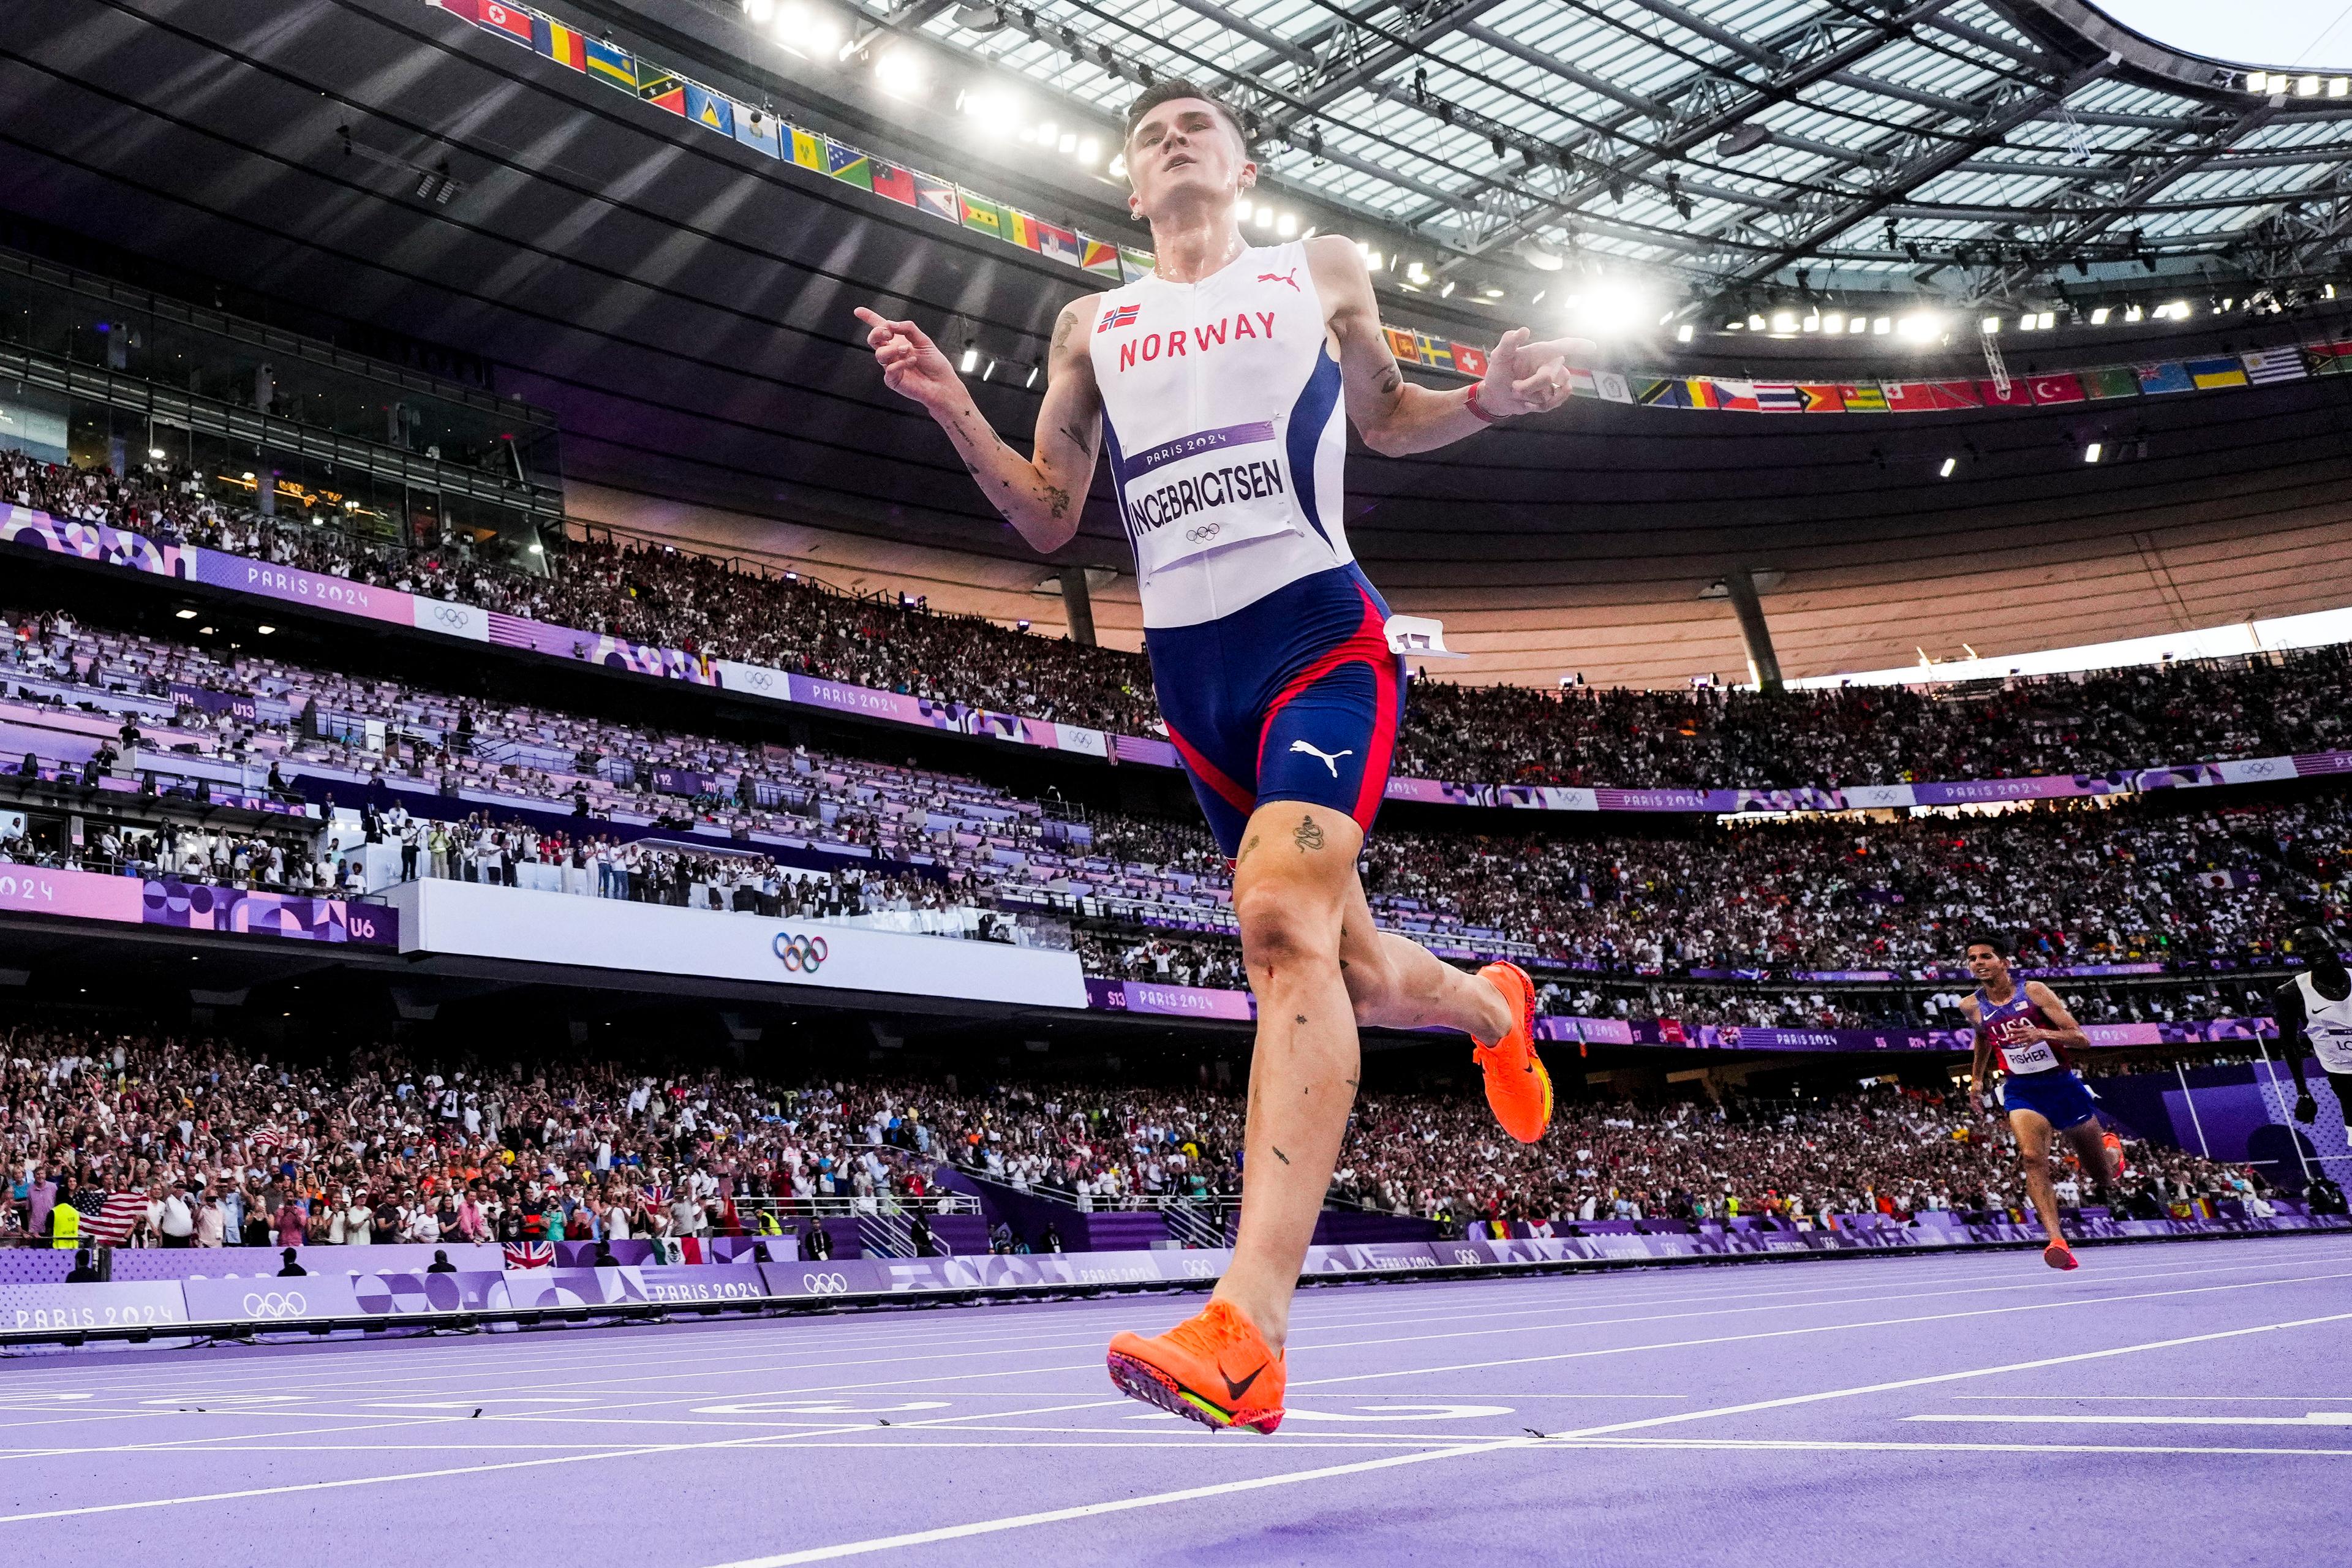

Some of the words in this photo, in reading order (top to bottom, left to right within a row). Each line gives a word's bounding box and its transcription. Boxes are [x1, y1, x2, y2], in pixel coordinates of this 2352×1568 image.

[1120, 312, 1275, 372] NORWAY
[1146, 445, 1183, 466] PARIS
[1186, 434, 1226, 451] 2024
[1129, 459, 1284, 536] INGEBRIGTSEN
[248, 567, 308, 595] PARIS
[316, 582, 368, 607] 2024
[812, 685, 856, 705] PARIS
[861, 694, 897, 712] 2024
[233, 702, 255, 718] U13
[1945, 785, 1992, 797] PARIS
[1997, 783, 2043, 795] 2024
[1623, 795, 1663, 807] PARIS
[1666, 795, 1703, 807] 2024
[350, 918, 375, 938] U6
[1107, 991, 1126, 1006] S13
[1139, 990, 1177, 1007] PARIS
[1177, 993, 1213, 1009] 2024
[1776, 1034, 1807, 1046] PARIS
[1809, 1034, 1838, 1046] 2024
[2010, 1049, 2049, 1065] FISHER
[656, 1284, 709, 1301] PARIS
[713, 1283, 761, 1299] 2024
[16, 1308, 95, 1329] PARIS
[105, 1305, 173, 1324] 2024
